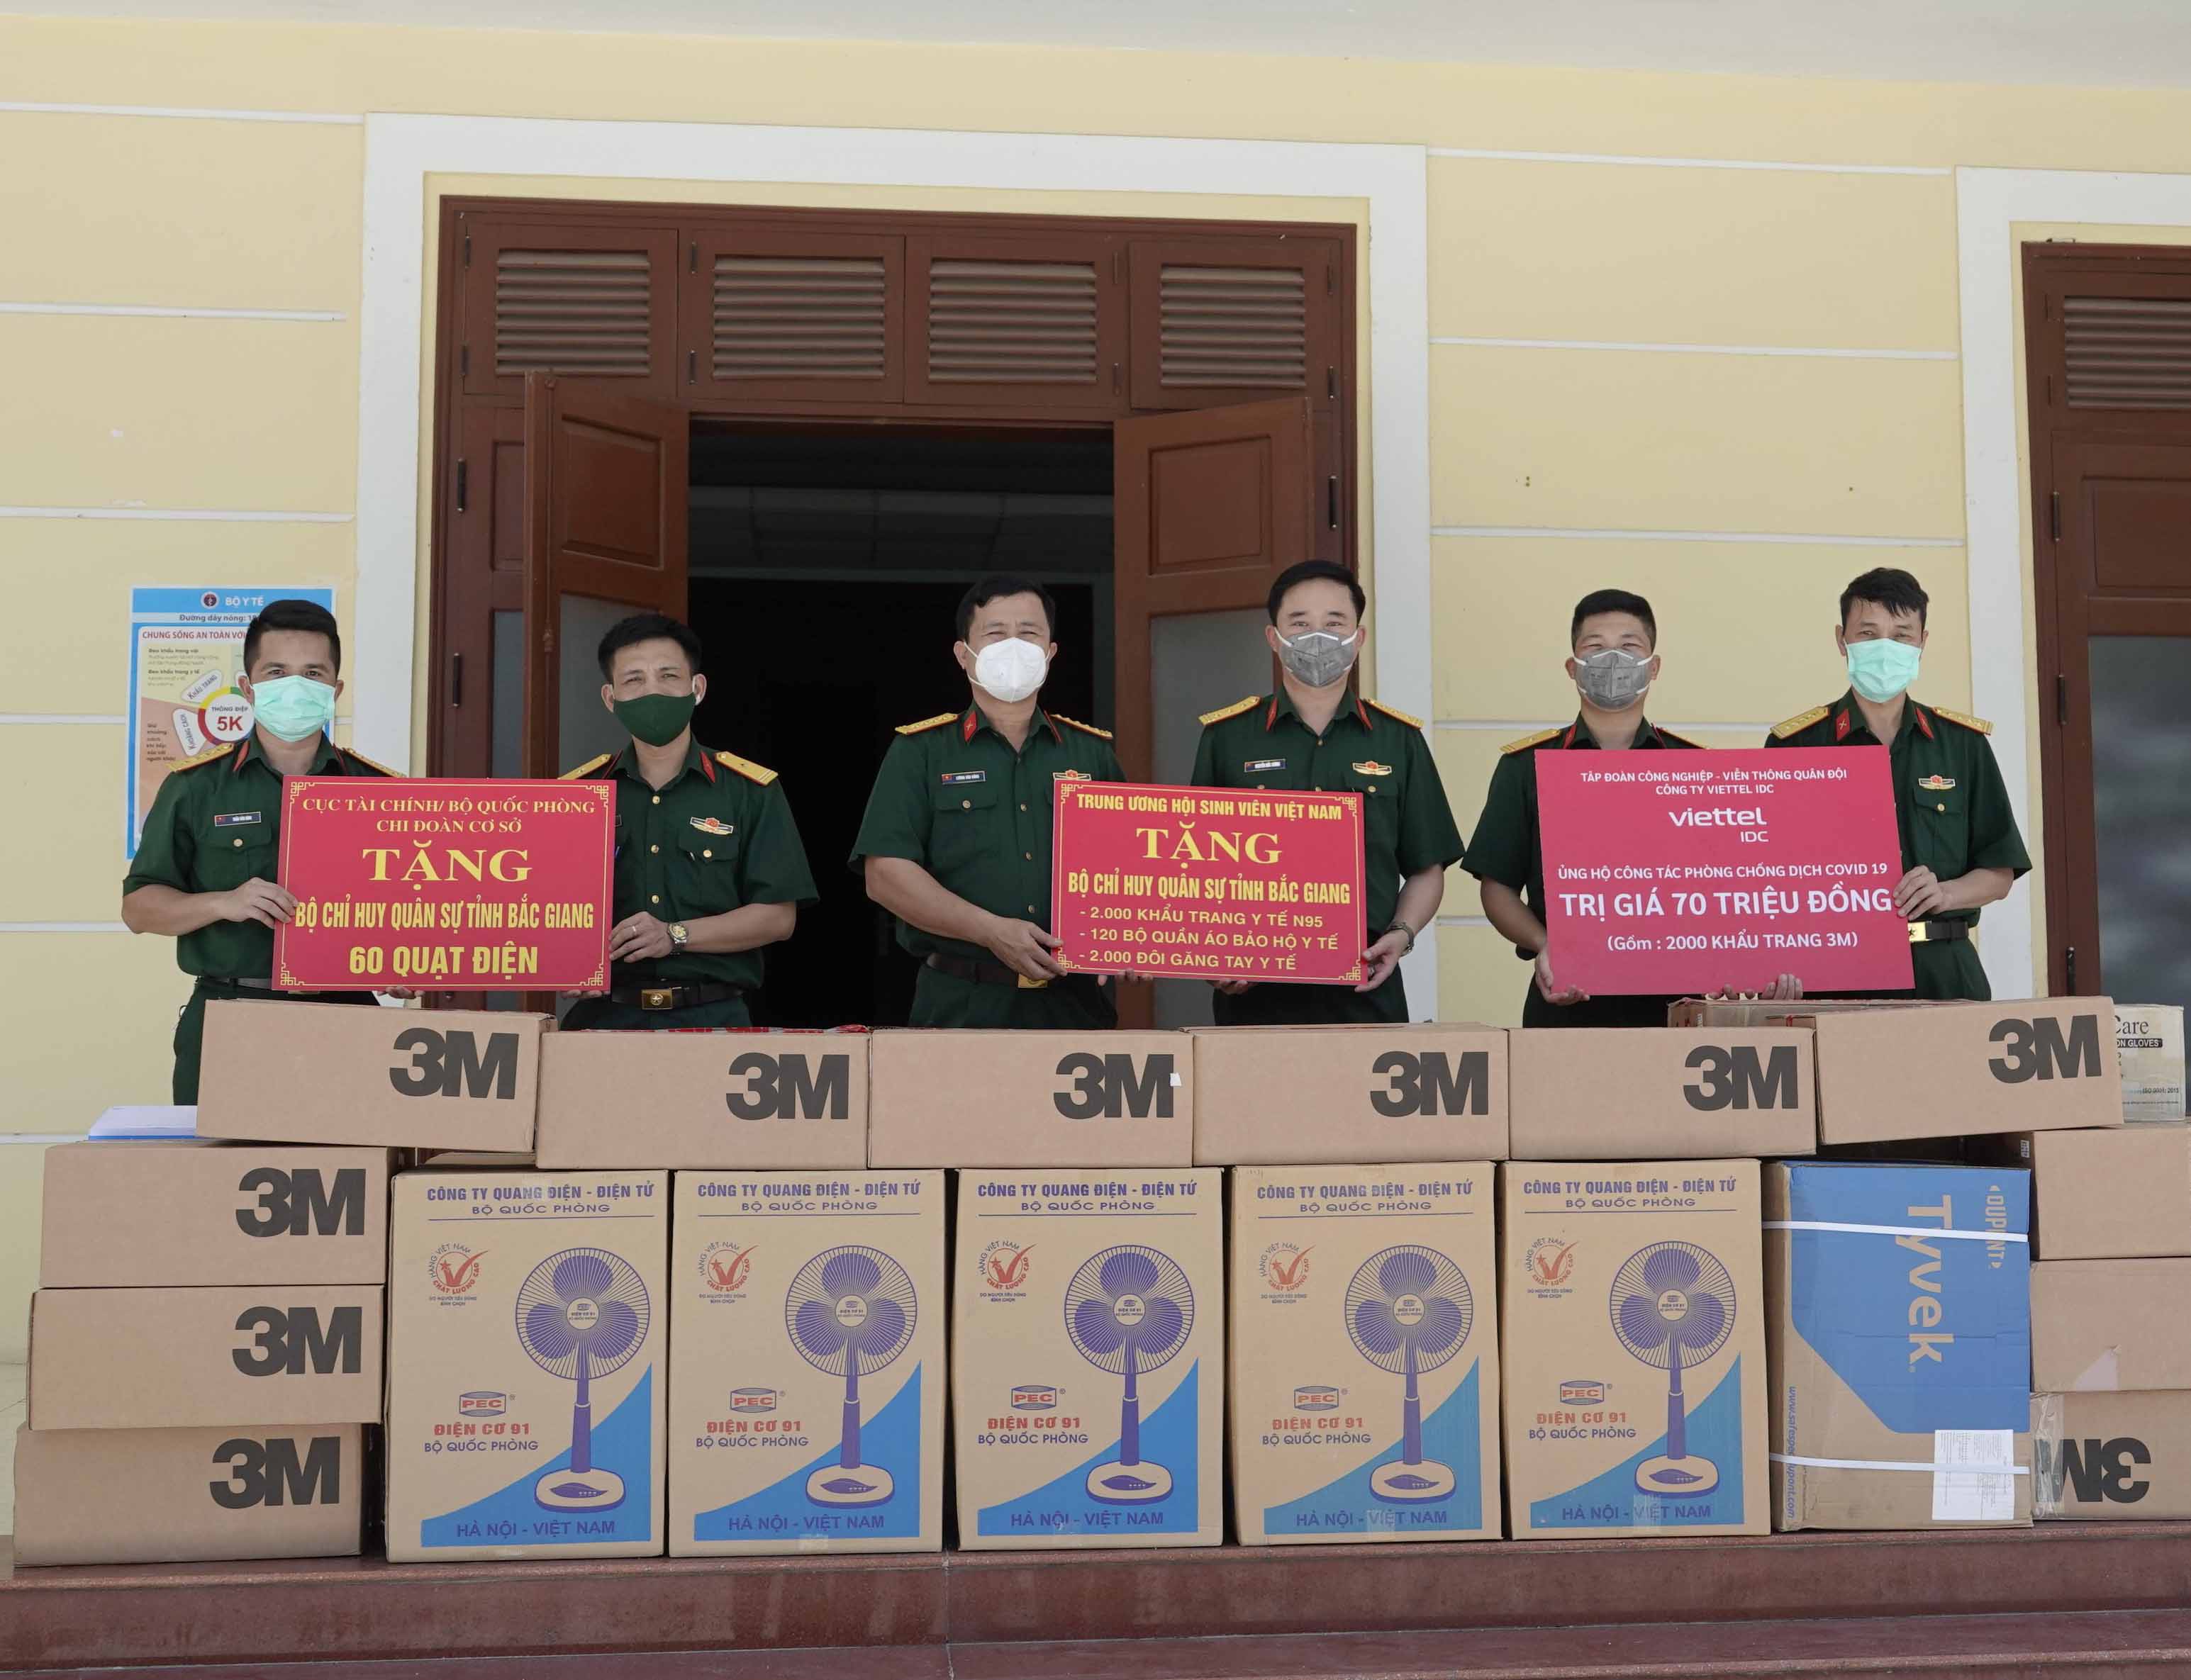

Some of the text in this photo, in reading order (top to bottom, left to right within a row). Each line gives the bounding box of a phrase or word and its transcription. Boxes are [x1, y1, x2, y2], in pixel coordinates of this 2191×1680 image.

[217, 716, 243, 732] 5K
[1604, 771, 1636, 783] ĐOÀN
[1637, 770, 1670, 782] CÔNG
[1671, 769, 1714, 783] NGHIỆP
[1722, 767, 1749, 781] VIỄN
[1751, 768, 1792, 780] THÔNG
[1793, 768, 1825, 781] QUÂN
[1827, 766, 1847, 780] ĐỘI
[1656, 783, 1774, 795] CÔNG TY VIETTEL IDC
[302, 795, 595, 815] CỤC TÀI CHÍNH/ BỘ QUỐC PHÒNG
[1076, 793, 1342, 822] TRUNG ƯƠNG HỘI SINH VIÊN VIỆT NAM
[377, 817, 522, 833] CHI ĐOÀN CƠ SỞ
[1668, 807, 1767, 827] viettel
[1136, 820, 1283, 869] TẶNG
[1740, 831, 1769, 843] IDC
[362, 839, 533, 891] TẶNG
[1558, 861, 1888, 882] ỦNG HỘ CÔNG TÁC PHÒNG CHỐNG DỊCH COVID 19
[1068, 867, 1351, 905] BỘ CHỈ HUY QUÂN SỰ TỈNH BẮC GIANG
[1559, 880, 1892, 922] TRỊ GIÁ 70 TRIỆU ĐỒNG
[295, 893, 594, 934] BỘ CHỈ HUY QUÂN SỰ TỈNH BẮC GIANG
[1090, 903, 1323, 928] 2.000 KHẨU TRANG Y TẾ N95
[1091, 926, 1338, 951] 120 BỘ QUẦN ÁO BẢO HỘ Y TẾ
[1607, 929, 1858, 951] (Gồm 2000 KHẨU TRANG 3M)
[349, 940, 538, 980] 60 QUẠT ĐIỆN
[1090, 949, 1296, 970] 2.000 ĐÔI GĂNG TAY Y TẾ
[1988, 1014, 2102, 1084] 3M
[389, 1027, 520, 1100] 3M
[725, 1052, 849, 1121] 3M
[1053, 1052, 1174, 1120] 3M
[1369, 1051, 1489, 1118] 3M
[1683, 1045, 1799, 1111] 3M
[978, 1182, 1016, 1197] CÔNG
[1021, 1184, 1037, 1197] TY
[1042, 1184, 1089, 1197] QUANG
[1093, 1181, 1127, 1199] ĐIỆN
[1142, 1181, 1175, 1199] ĐIỆN
[235, 1167, 367, 1238] 3M
[1021, 1199, 1155, 1212] BỘ QUỐC PHÒNG
[1895, 1194, 1955, 1365] Tyvek
[232, 1306, 362, 1377] 3M
[462, 1399, 501, 1409] PEC
[735, 1396, 773, 1406] PEC
[1014, 1394, 1053, 1403] PEC
[1298, 1394, 1334, 1404] PEC
[1563, 1389, 1599, 1398] PEC
[987, 1416, 1081, 1431] ĐIỆN CƠ 91
[978, 1430, 1088, 1446] BỘ QUỐC PHÒNG
[209, 1435, 341, 1509] 3M
[2035, 1437, 2151, 1503] 3M
[1010, 1509, 1164, 1528] HÀ NỘI VIỆT NAM
